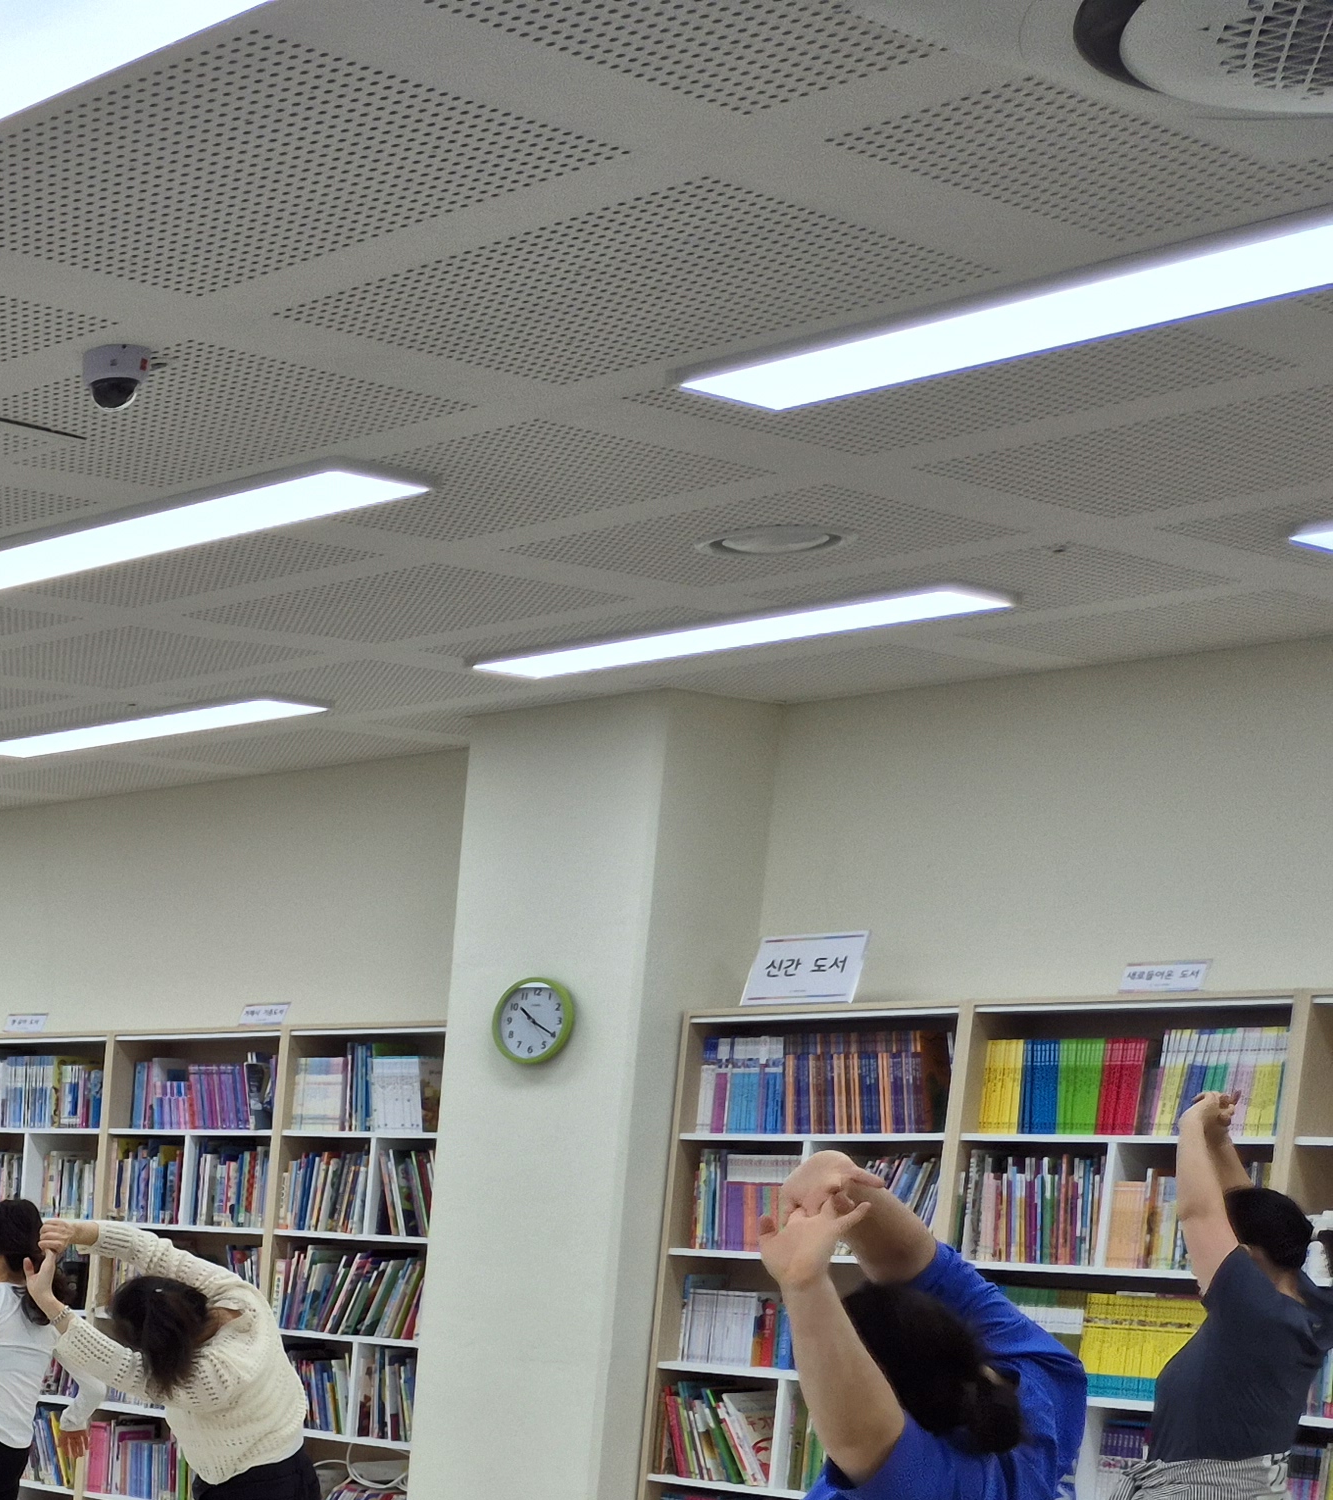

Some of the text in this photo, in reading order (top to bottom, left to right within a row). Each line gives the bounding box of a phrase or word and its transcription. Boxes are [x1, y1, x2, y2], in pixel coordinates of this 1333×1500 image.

[765, 955, 848, 978] 신간 도서
[1179, 969, 1200, 979] 도서
[521, 992, 529, 1000] 11
[510, 1003, 519, 1011] 10
[555, 1003, 561, 1011] 2
[507, 1017, 512, 1025] 9
[557, 1017, 562, 1025] 3
